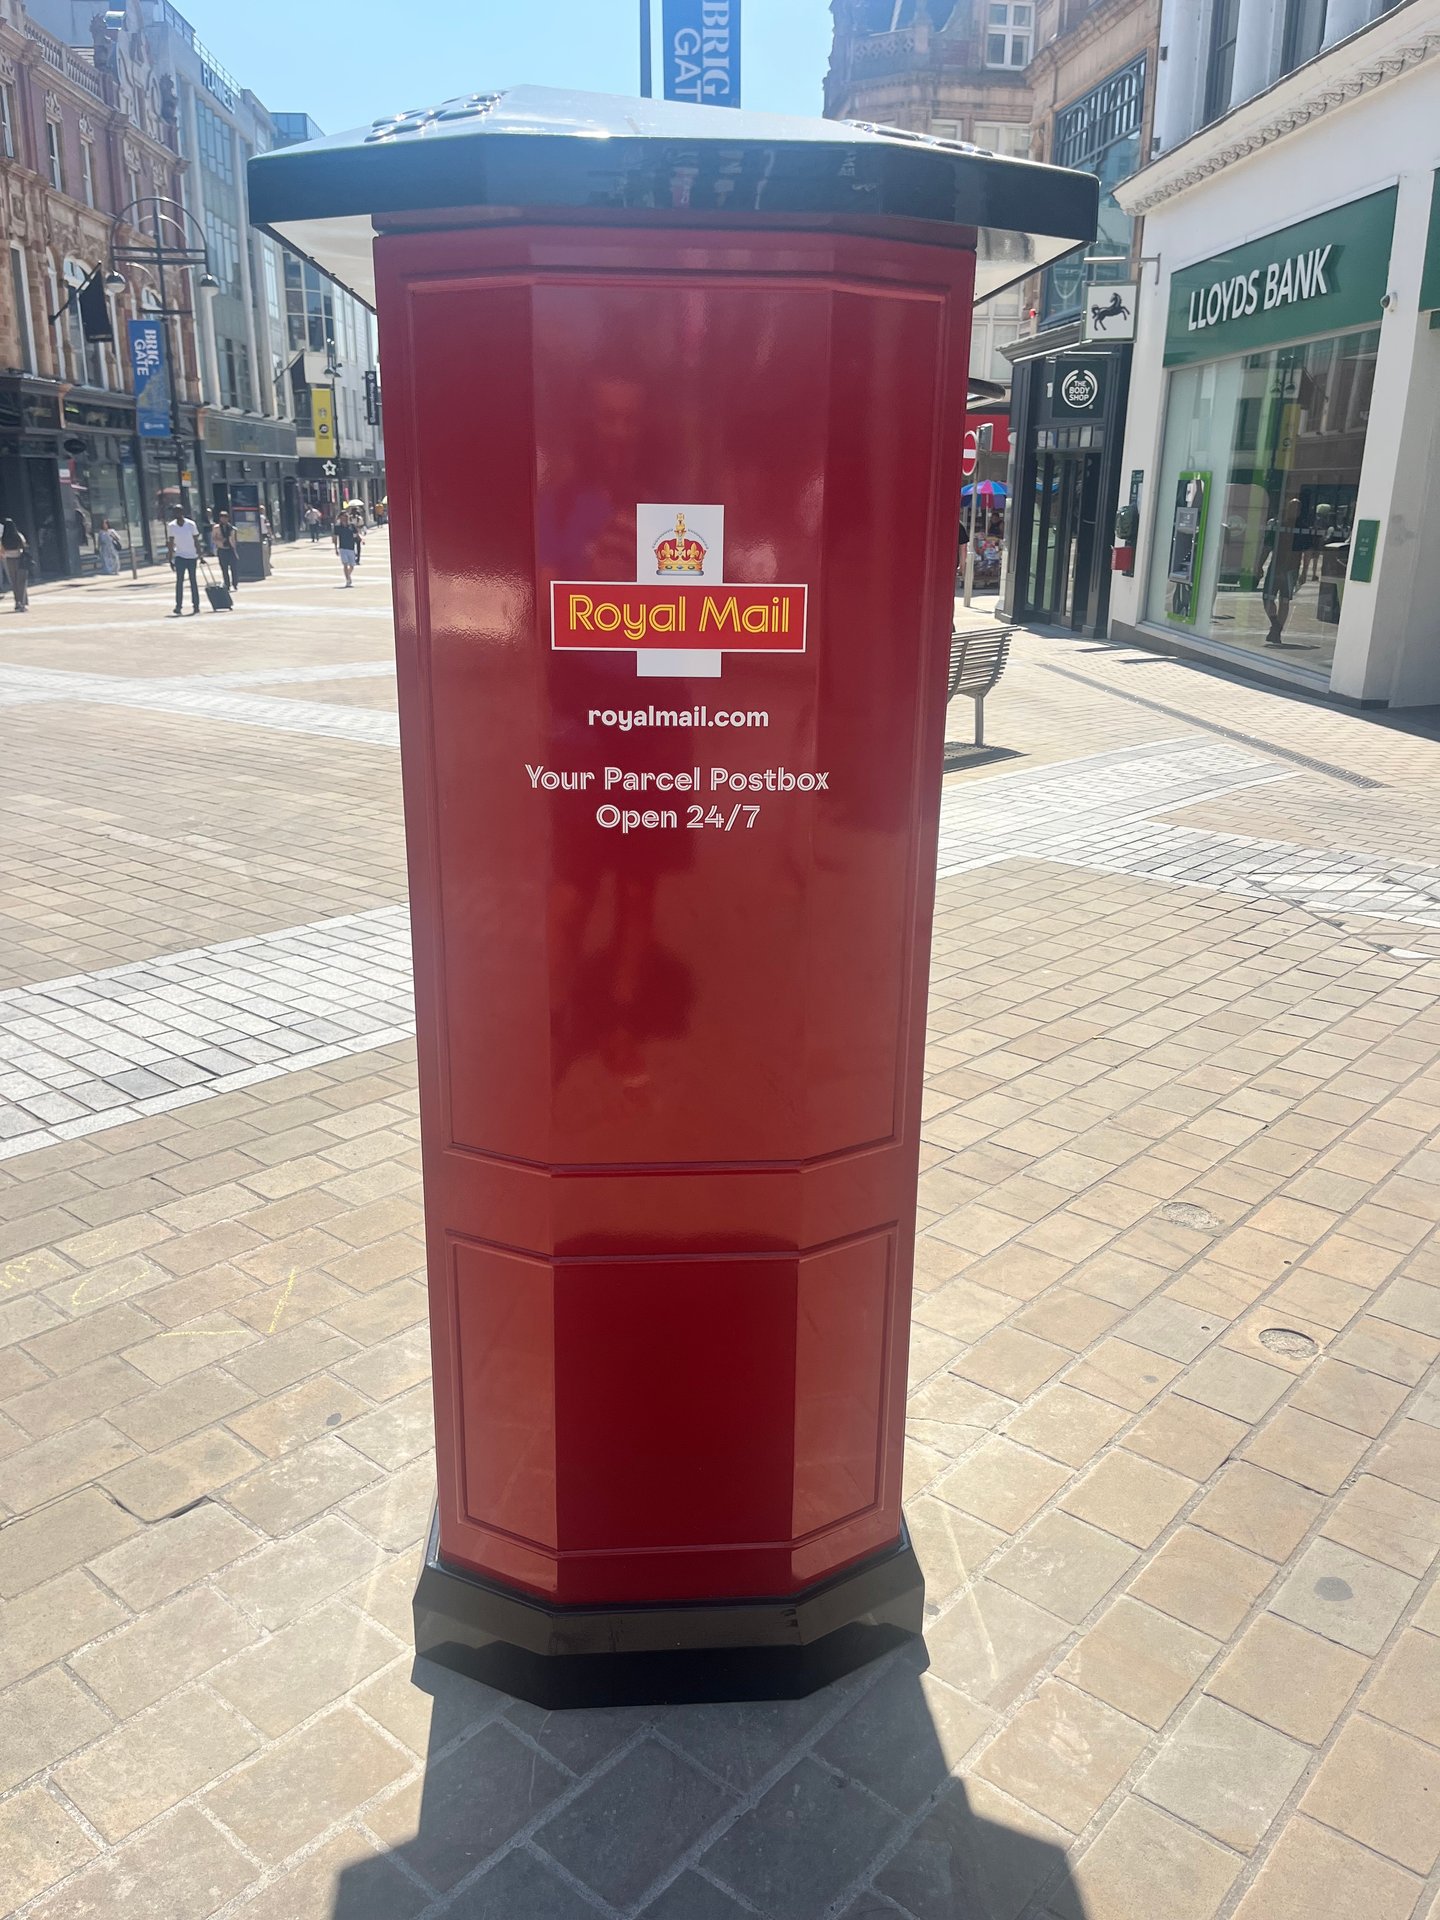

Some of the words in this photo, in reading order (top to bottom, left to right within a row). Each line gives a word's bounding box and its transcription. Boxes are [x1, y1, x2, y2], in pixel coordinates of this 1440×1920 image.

[674, 28, 702, 103] GAT
[702, 1, 729, 96] BRIG
[1188, 269, 1260, 331] LLOYDS
[1263, 244, 1332, 310] BANK
[134, 339, 150, 376] GATE
[144, 329, 160, 365] BRIG
[1068, 386, 1090, 394] BODY
[568, 594, 686, 640] Royal
[699, 596, 790, 633] Mail
[588, 705, 769, 731] royalmail.com
[525, 764, 595, 790] Your
[604, 766, 700, 791] Parcel
[710, 767, 830, 792] Postbox
[596, 804, 678, 834] Open
[686, 804, 761, 831] 24/7
